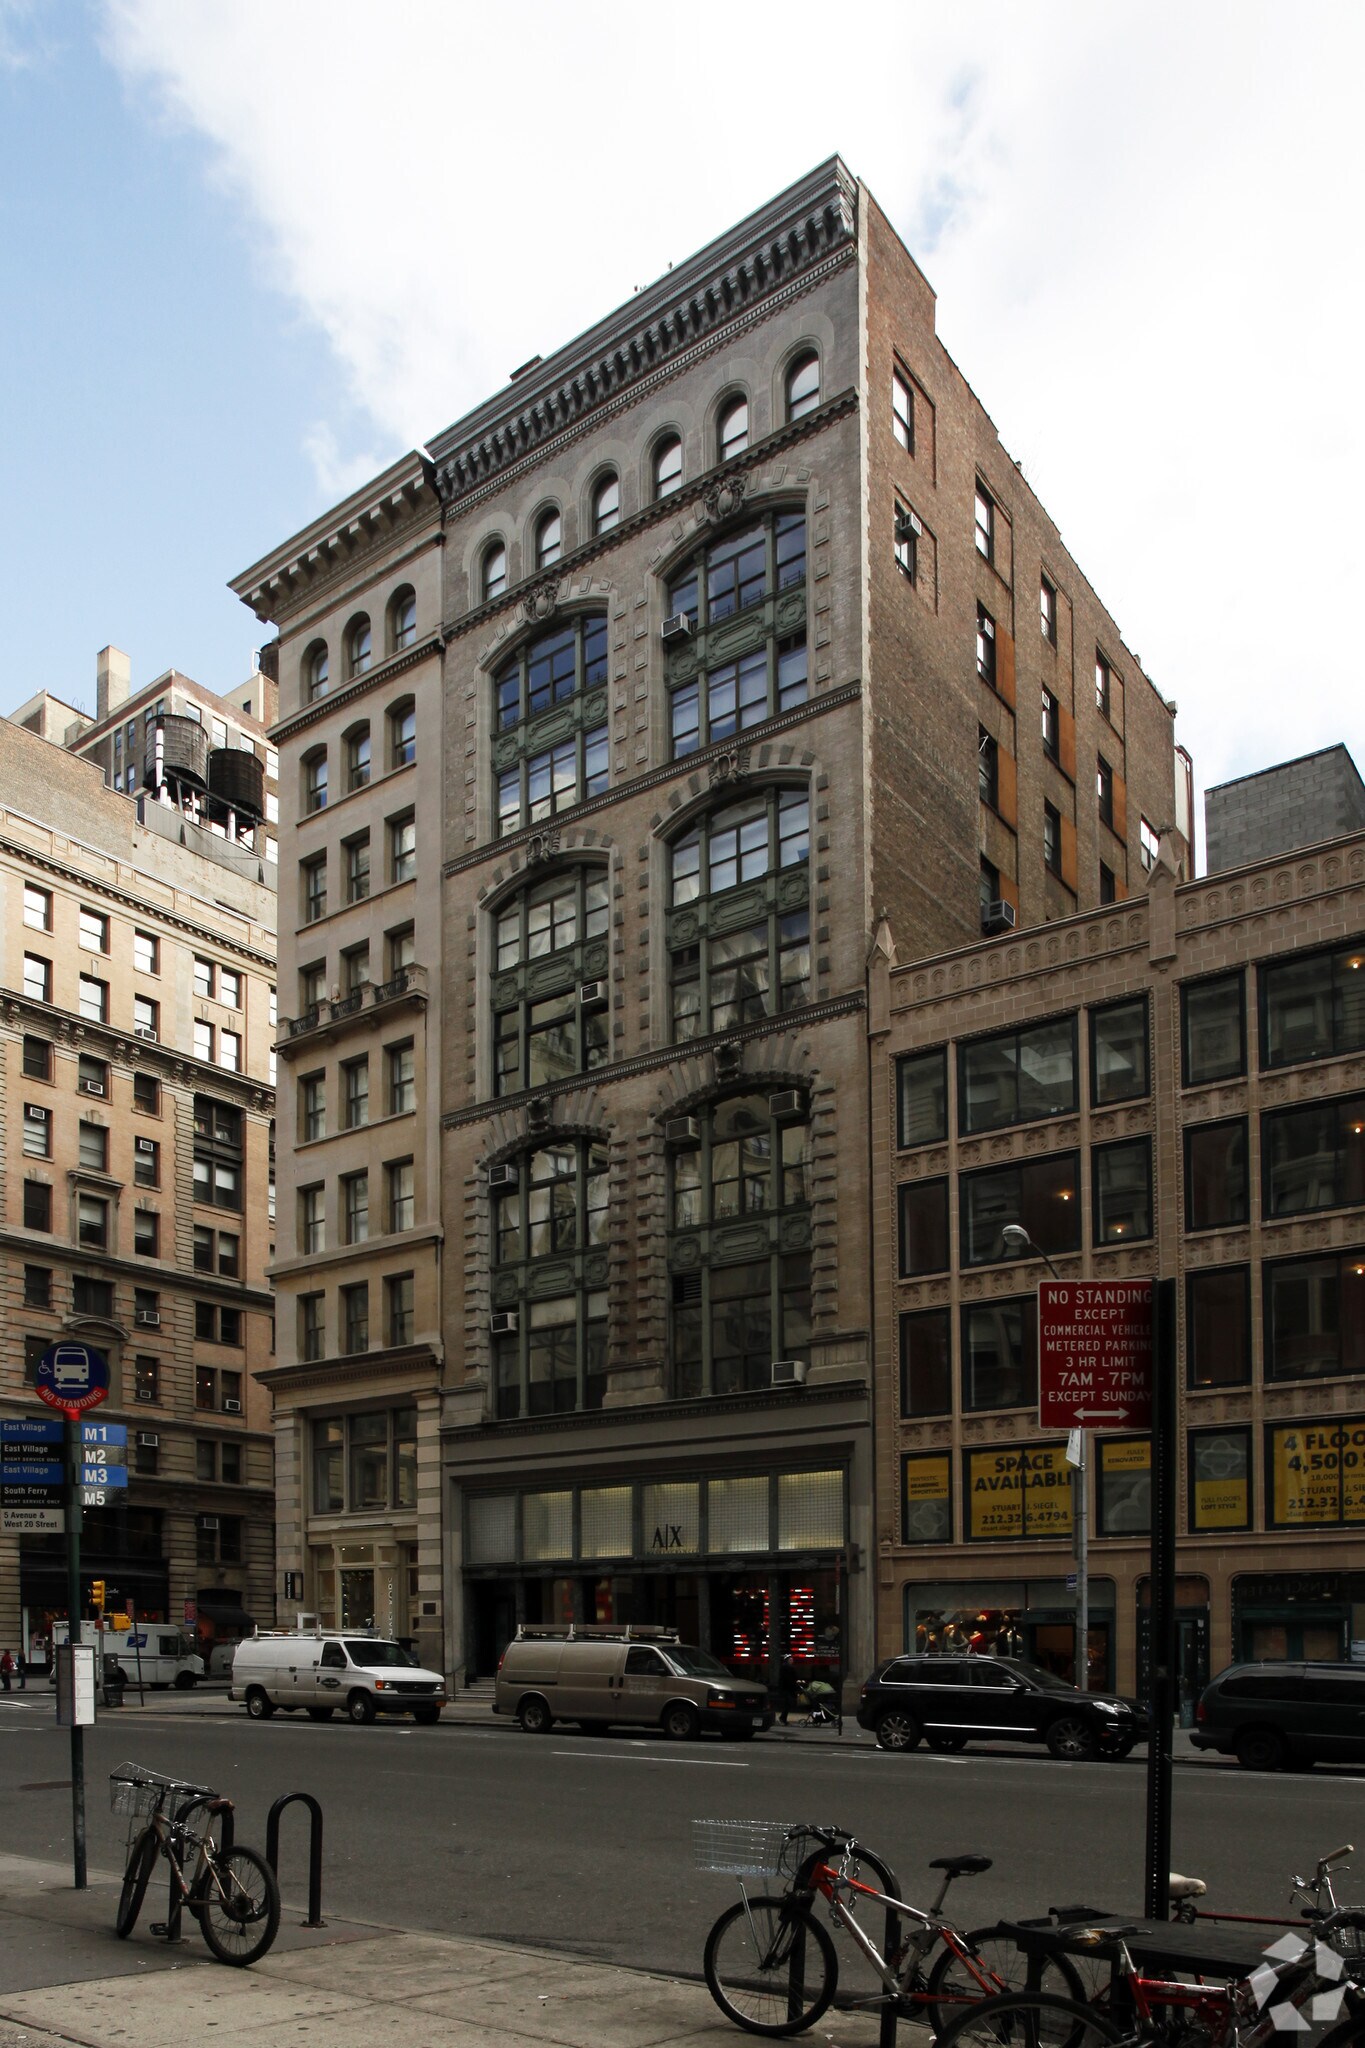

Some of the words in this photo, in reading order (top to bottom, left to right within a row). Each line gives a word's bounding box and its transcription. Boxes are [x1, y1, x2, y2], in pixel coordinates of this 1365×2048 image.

[1048, 1290, 1069, 1304] NO
[1075, 1289, 1152, 1304] STANDING
[1074, 1309, 1126, 1320] EXCEPT
[1043, 1325, 1107, 1336] COMMERCIAL
[1112, 1324, 1151, 1336] VEHICLE
[1046, 1340, 1101, 1351] METERED
[1065, 1356, 1073, 1367] 3
[1078, 1356, 1097, 1367] HR
[1101, 1356, 1136, 1367] LIMIT
[1058, 1372, 1093, 1386] 7AM
[1108, 1371, 1145, 1386] 7PM
[41, 1388, 55, 1401] NO
[55, 1390, 102, 1408] STANDING
[1048, 1391, 1096, 1402] EXCEPT
[1102, 1391, 1152, 1402] SUNDAY
[3, 1423, 20, 1431] East
[21, 1423, 46, 1432] Village
[84, 1426, 107, 1442] M1
[4, 1444, 20, 1453] East
[21, 1444, 49, 1454] Village
[1284, 1435, 1297, 1450] 4
[85, 1449, 107, 1464] M2
[1288, 1451, 1358, 1474] 4,500
[3, 1465, 20, 1474] East
[21, 1466, 49, 1475] Village
[994, 1454, 1053, 1473] SPACE
[84, 1468, 108, 1484] M3
[4, 1486, 26, 1495] South
[27, 1486, 48, 1496] Ferry
[1300, 1485, 1337, 1495] STUART
[84, 1491, 106, 1506] M5
[992, 1503, 1021, 1512] STUART
[982, 1511, 1069, 1525] 212.326.4794
